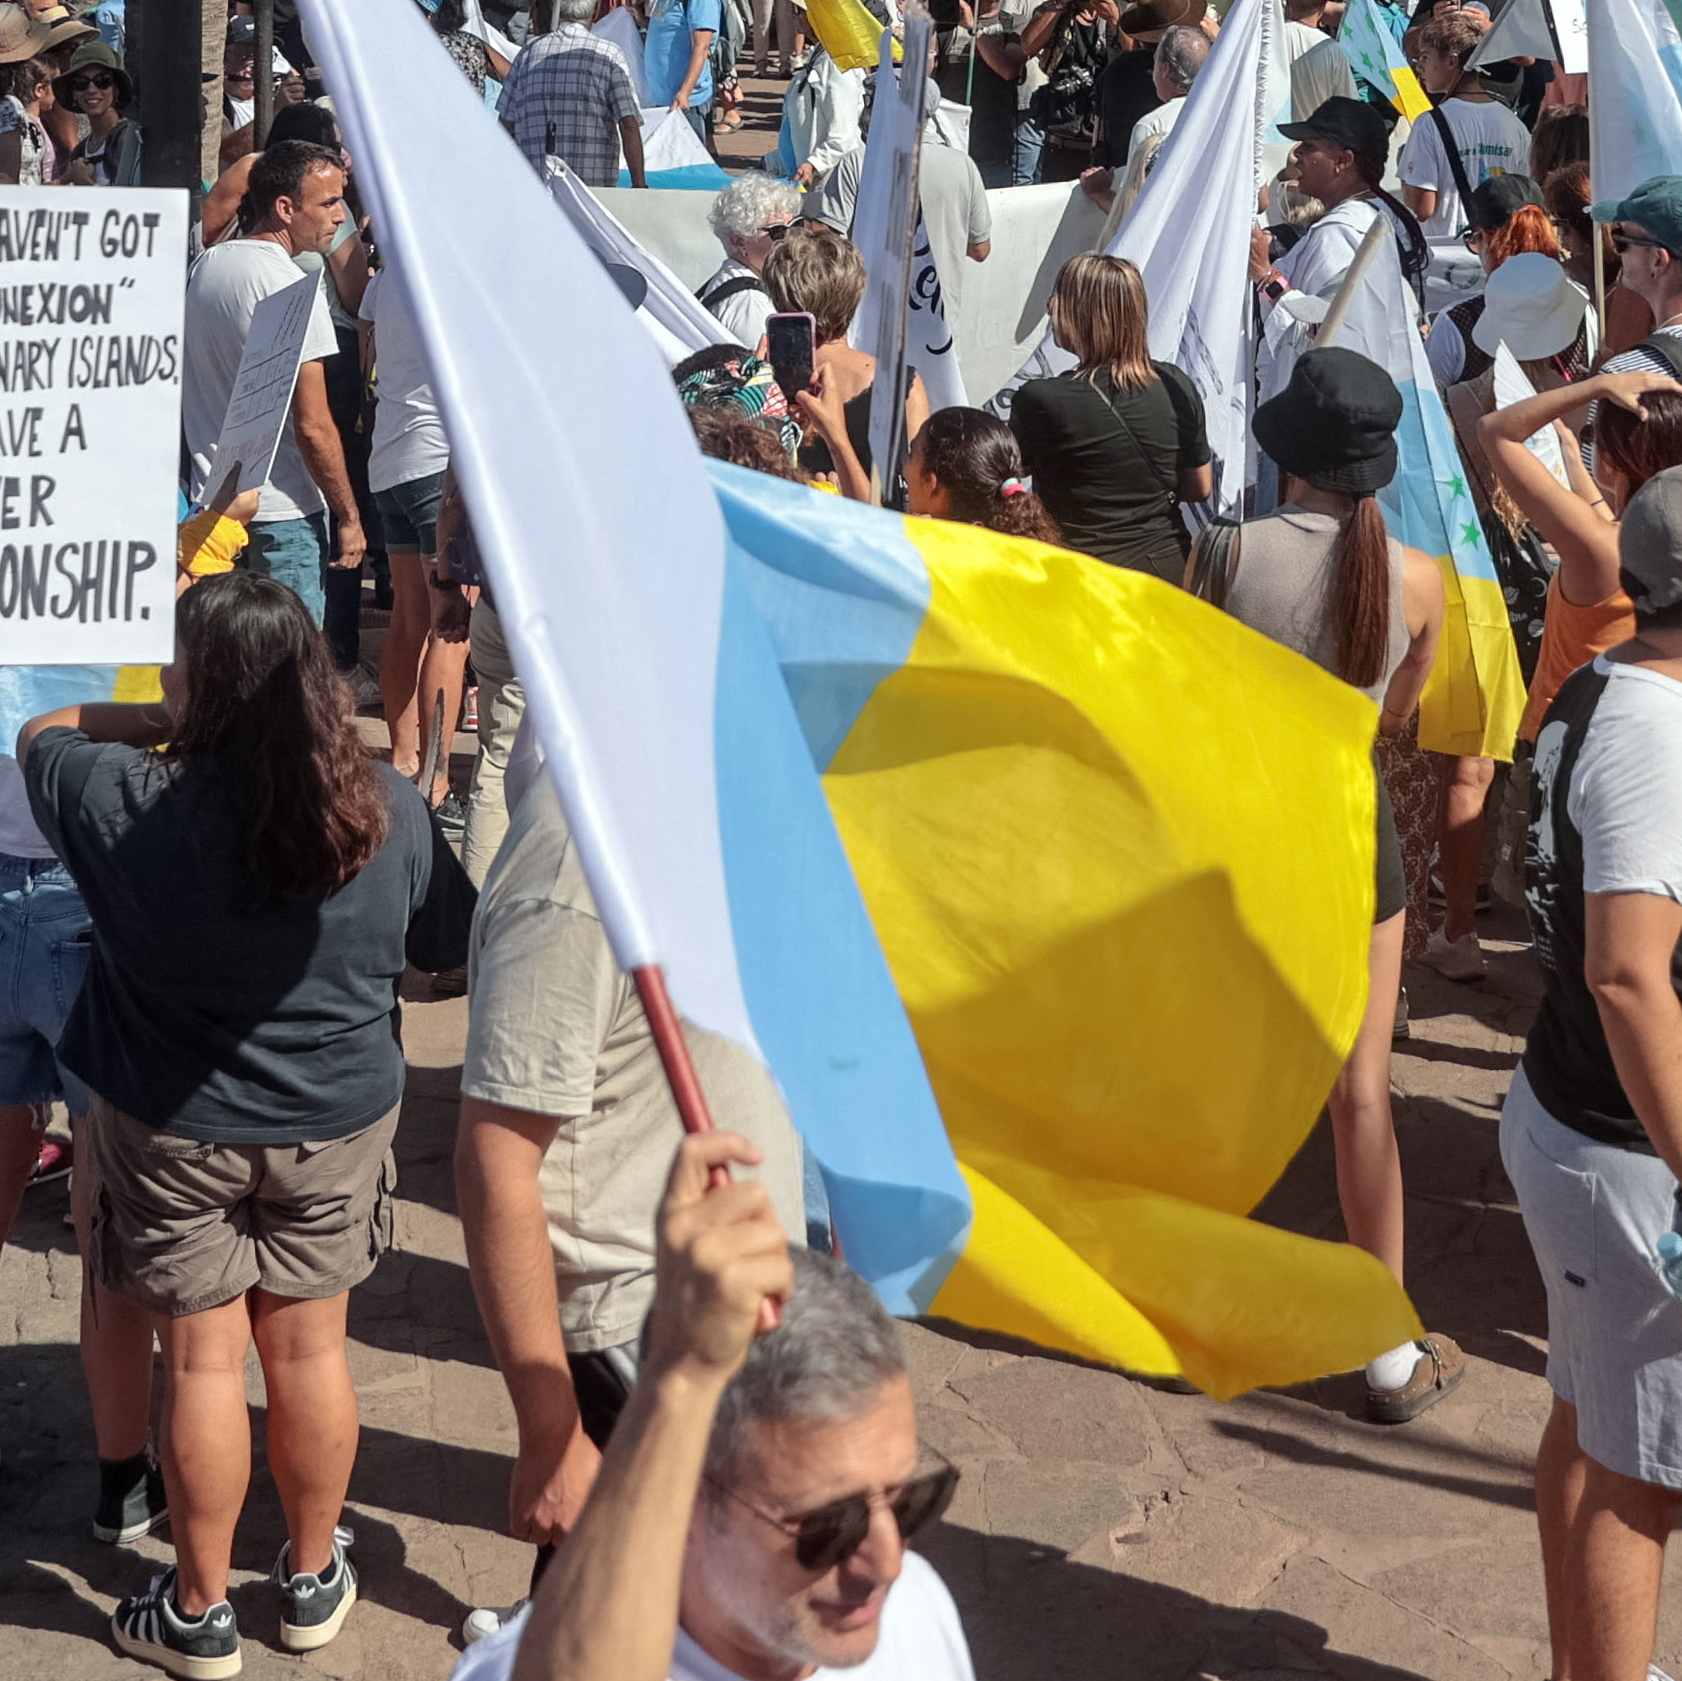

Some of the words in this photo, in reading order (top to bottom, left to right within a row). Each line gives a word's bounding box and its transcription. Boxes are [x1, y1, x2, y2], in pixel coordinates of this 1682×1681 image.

[100, 208, 161, 259] GOT
[68, 334, 179, 389] ISLANDS.
[59, 403, 88, 453] A
